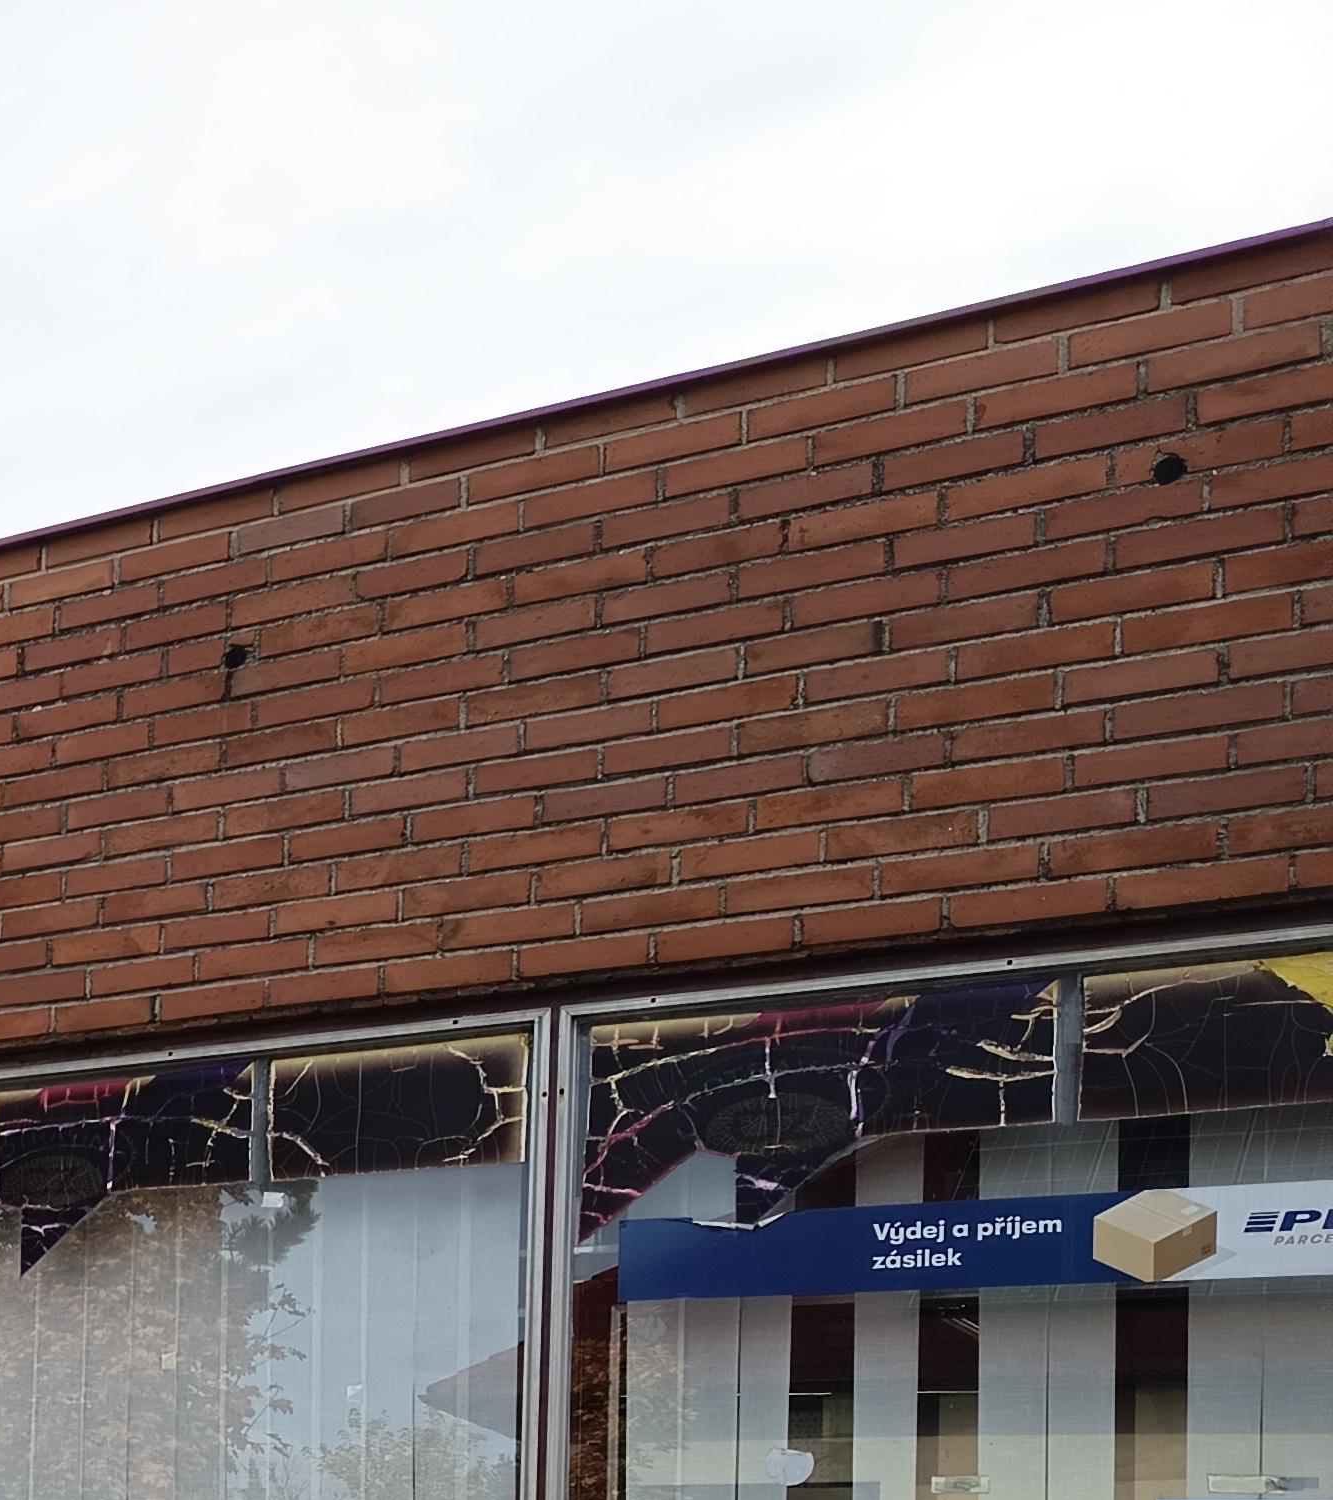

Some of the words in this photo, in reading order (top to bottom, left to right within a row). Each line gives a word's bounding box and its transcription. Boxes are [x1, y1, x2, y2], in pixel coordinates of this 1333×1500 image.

[873, 1220, 946, 1245] Výdej
[952, 1223, 969, 1237] a
[977, 1216, 1062, 1241] příjem
[872, 1248, 962, 1269] zásilek
